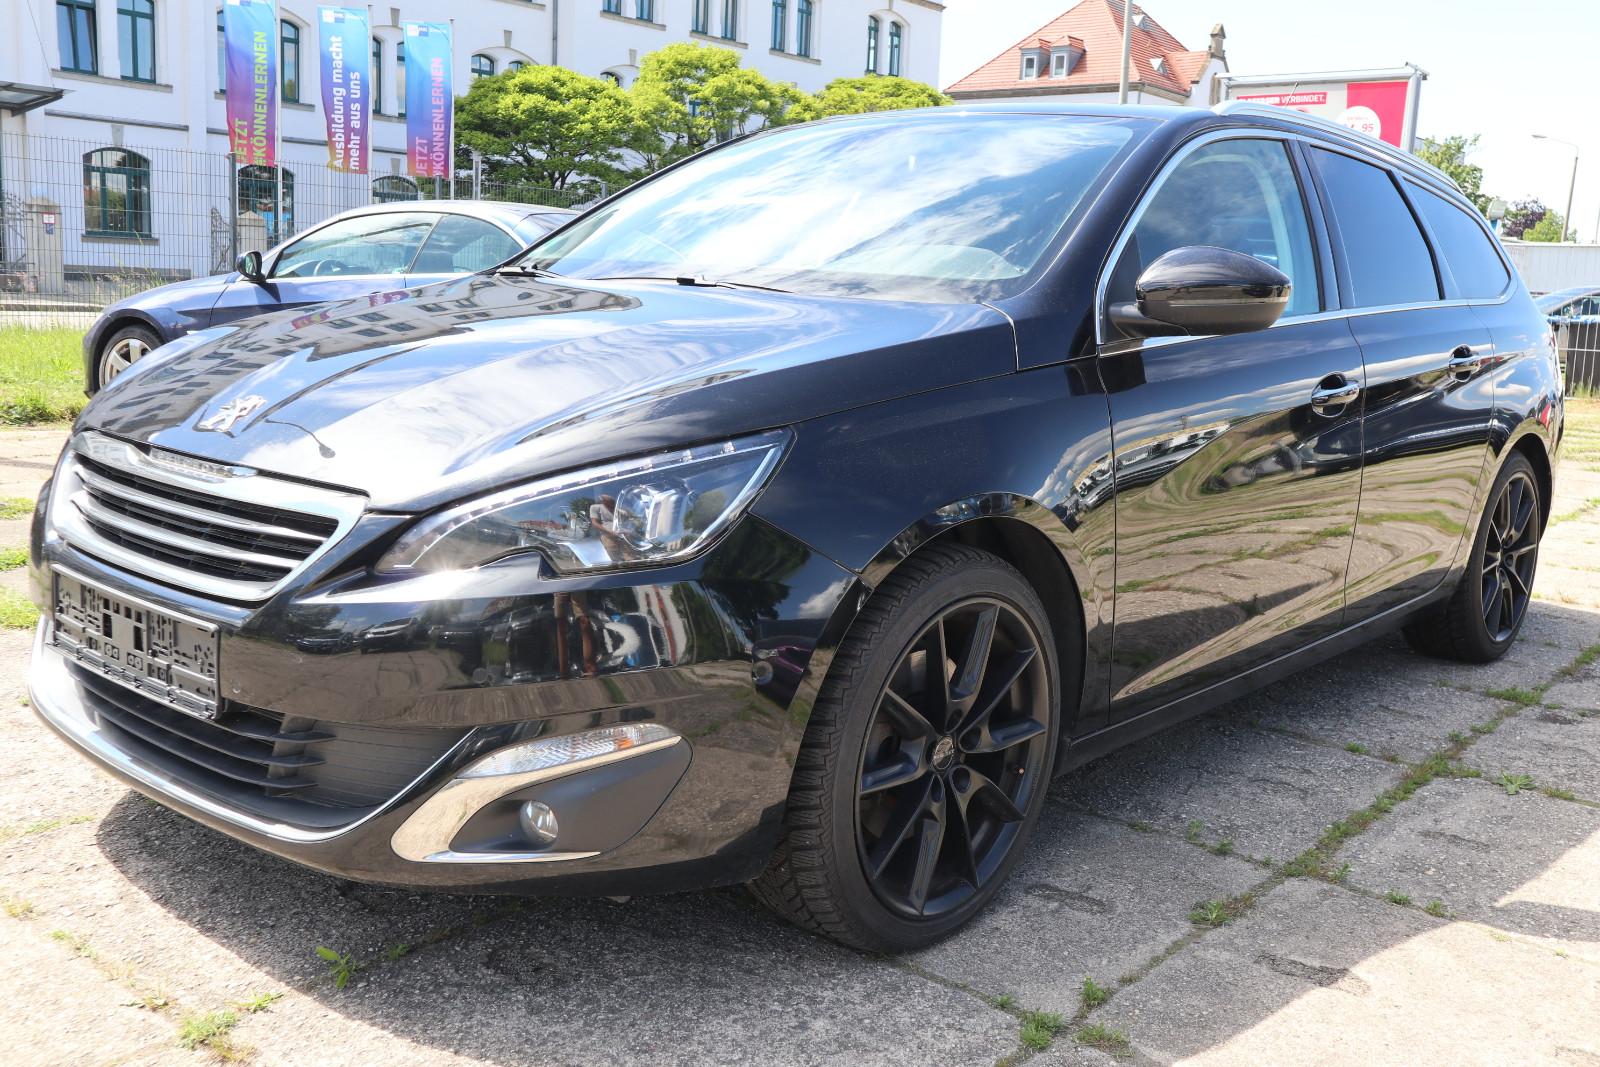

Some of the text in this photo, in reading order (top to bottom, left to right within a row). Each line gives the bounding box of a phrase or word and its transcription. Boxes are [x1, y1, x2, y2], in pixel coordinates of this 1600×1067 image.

[329, 36, 346, 168] Ausbildung macht
[347, 71, 360, 170] mehr aus uns
[416, 136, 428, 177] JETZT
